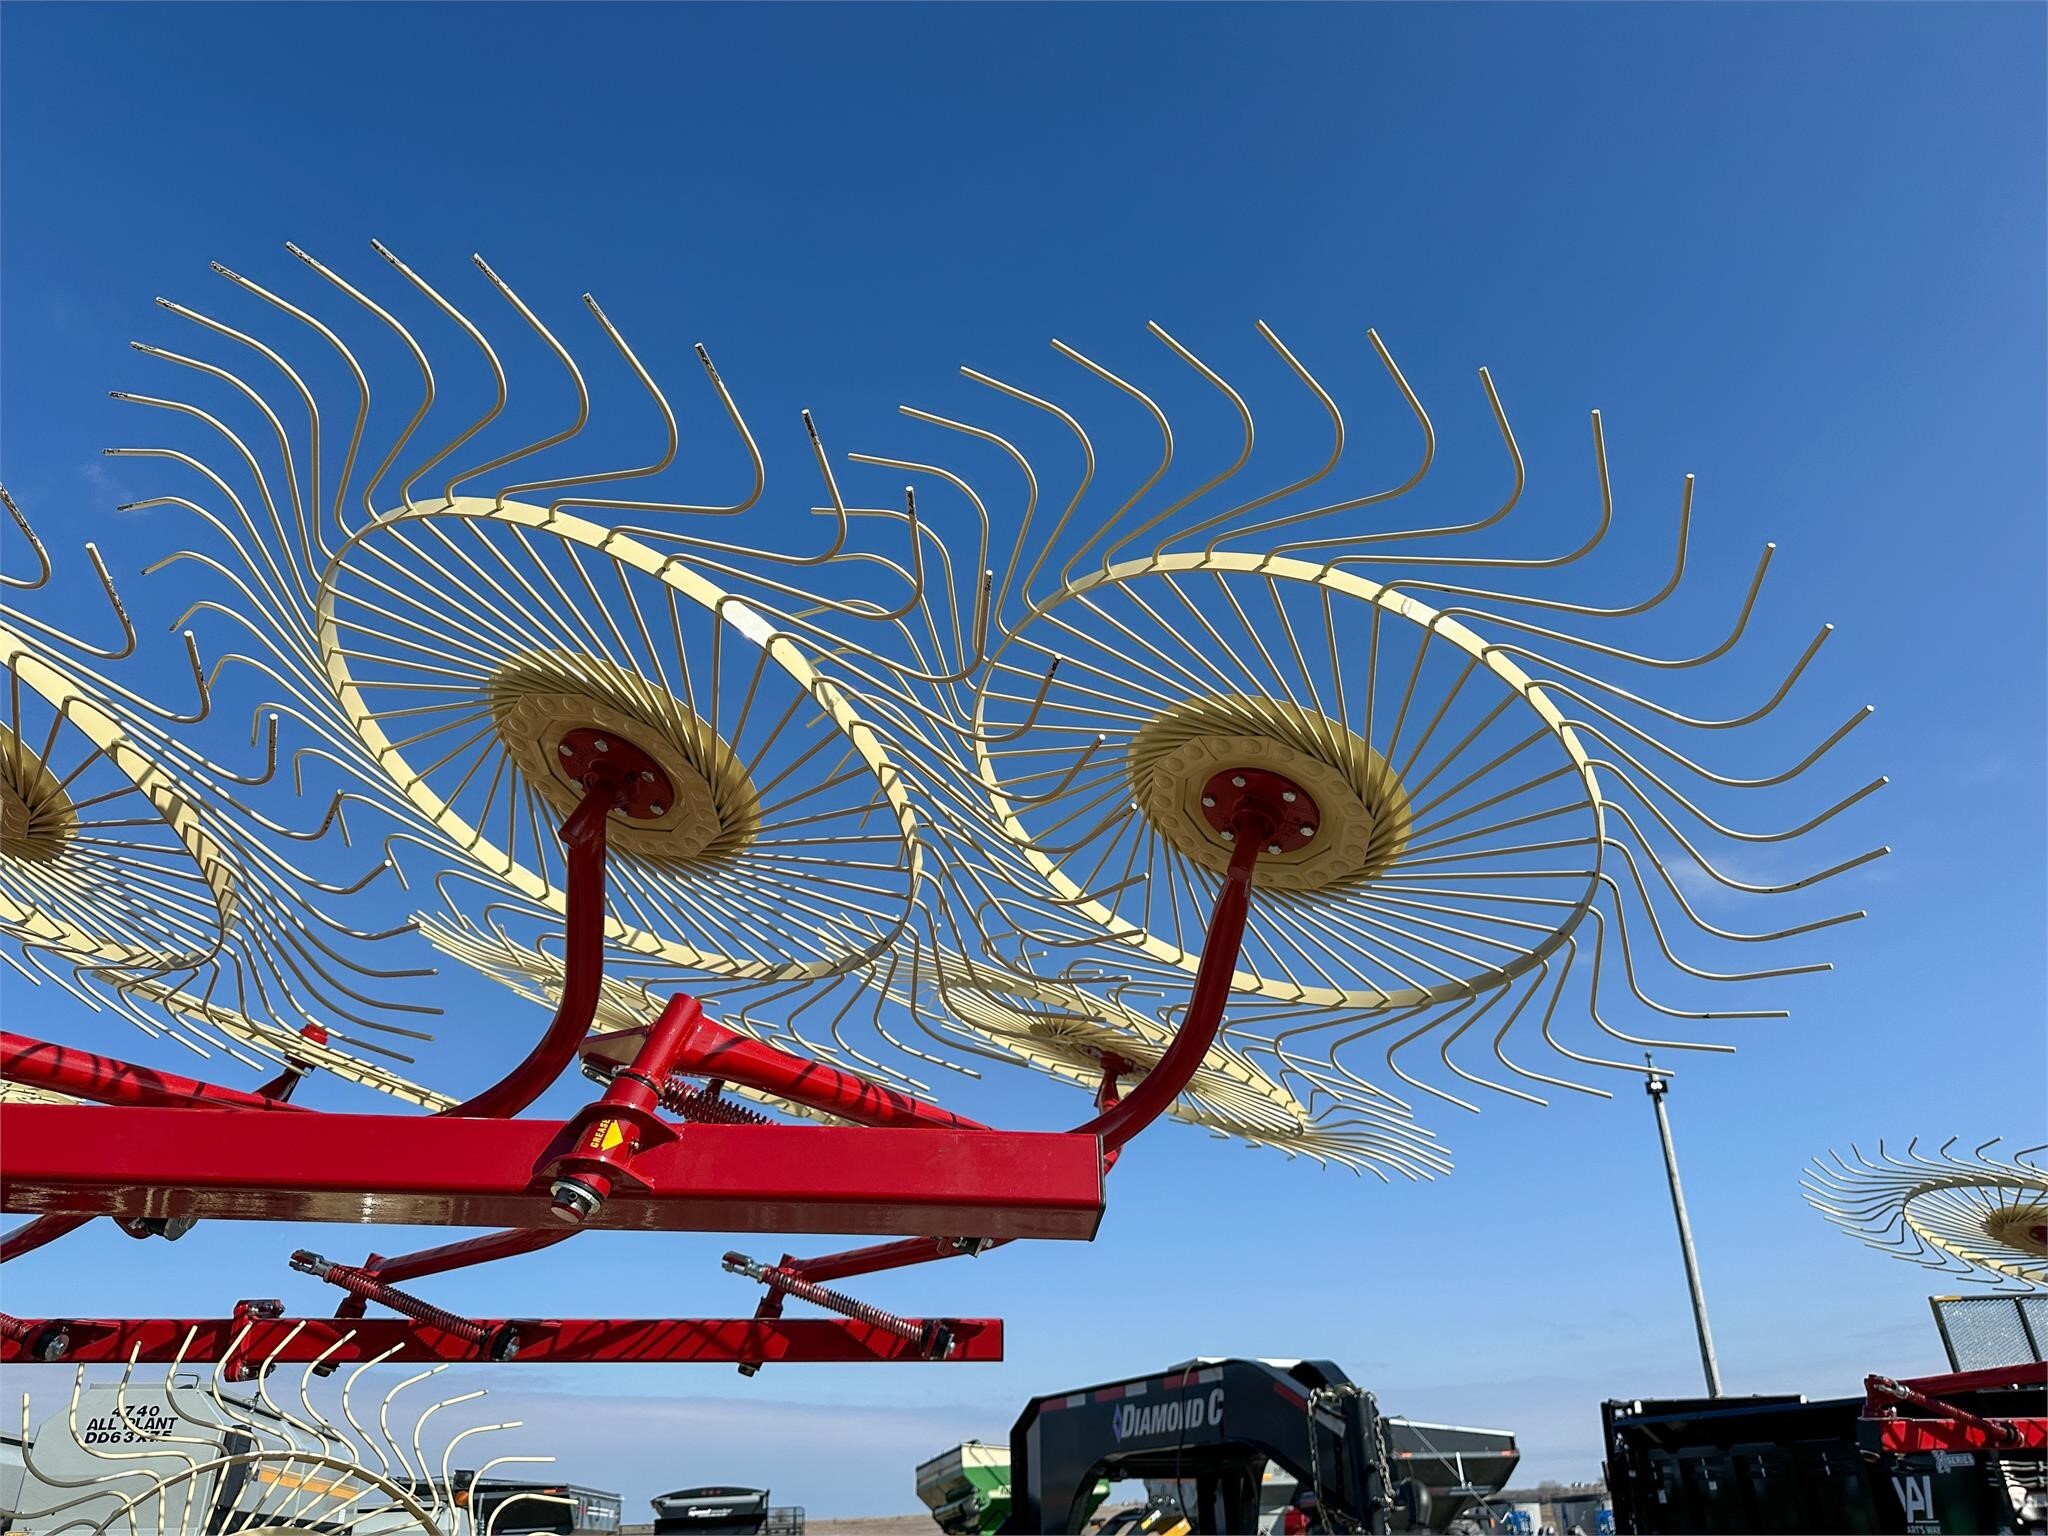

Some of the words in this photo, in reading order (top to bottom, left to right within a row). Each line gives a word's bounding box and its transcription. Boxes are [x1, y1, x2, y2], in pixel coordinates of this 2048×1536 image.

[590, 1118, 611, 1148] GREASE
[112, 1405, 160, 1417] 4740
[1120, 1397, 1205, 1439] DIAMOND
[1207, 1387, 1225, 1426] C
[86, 1418, 117, 1430] ALL
[123, 1417, 178, 1430] PLANT
